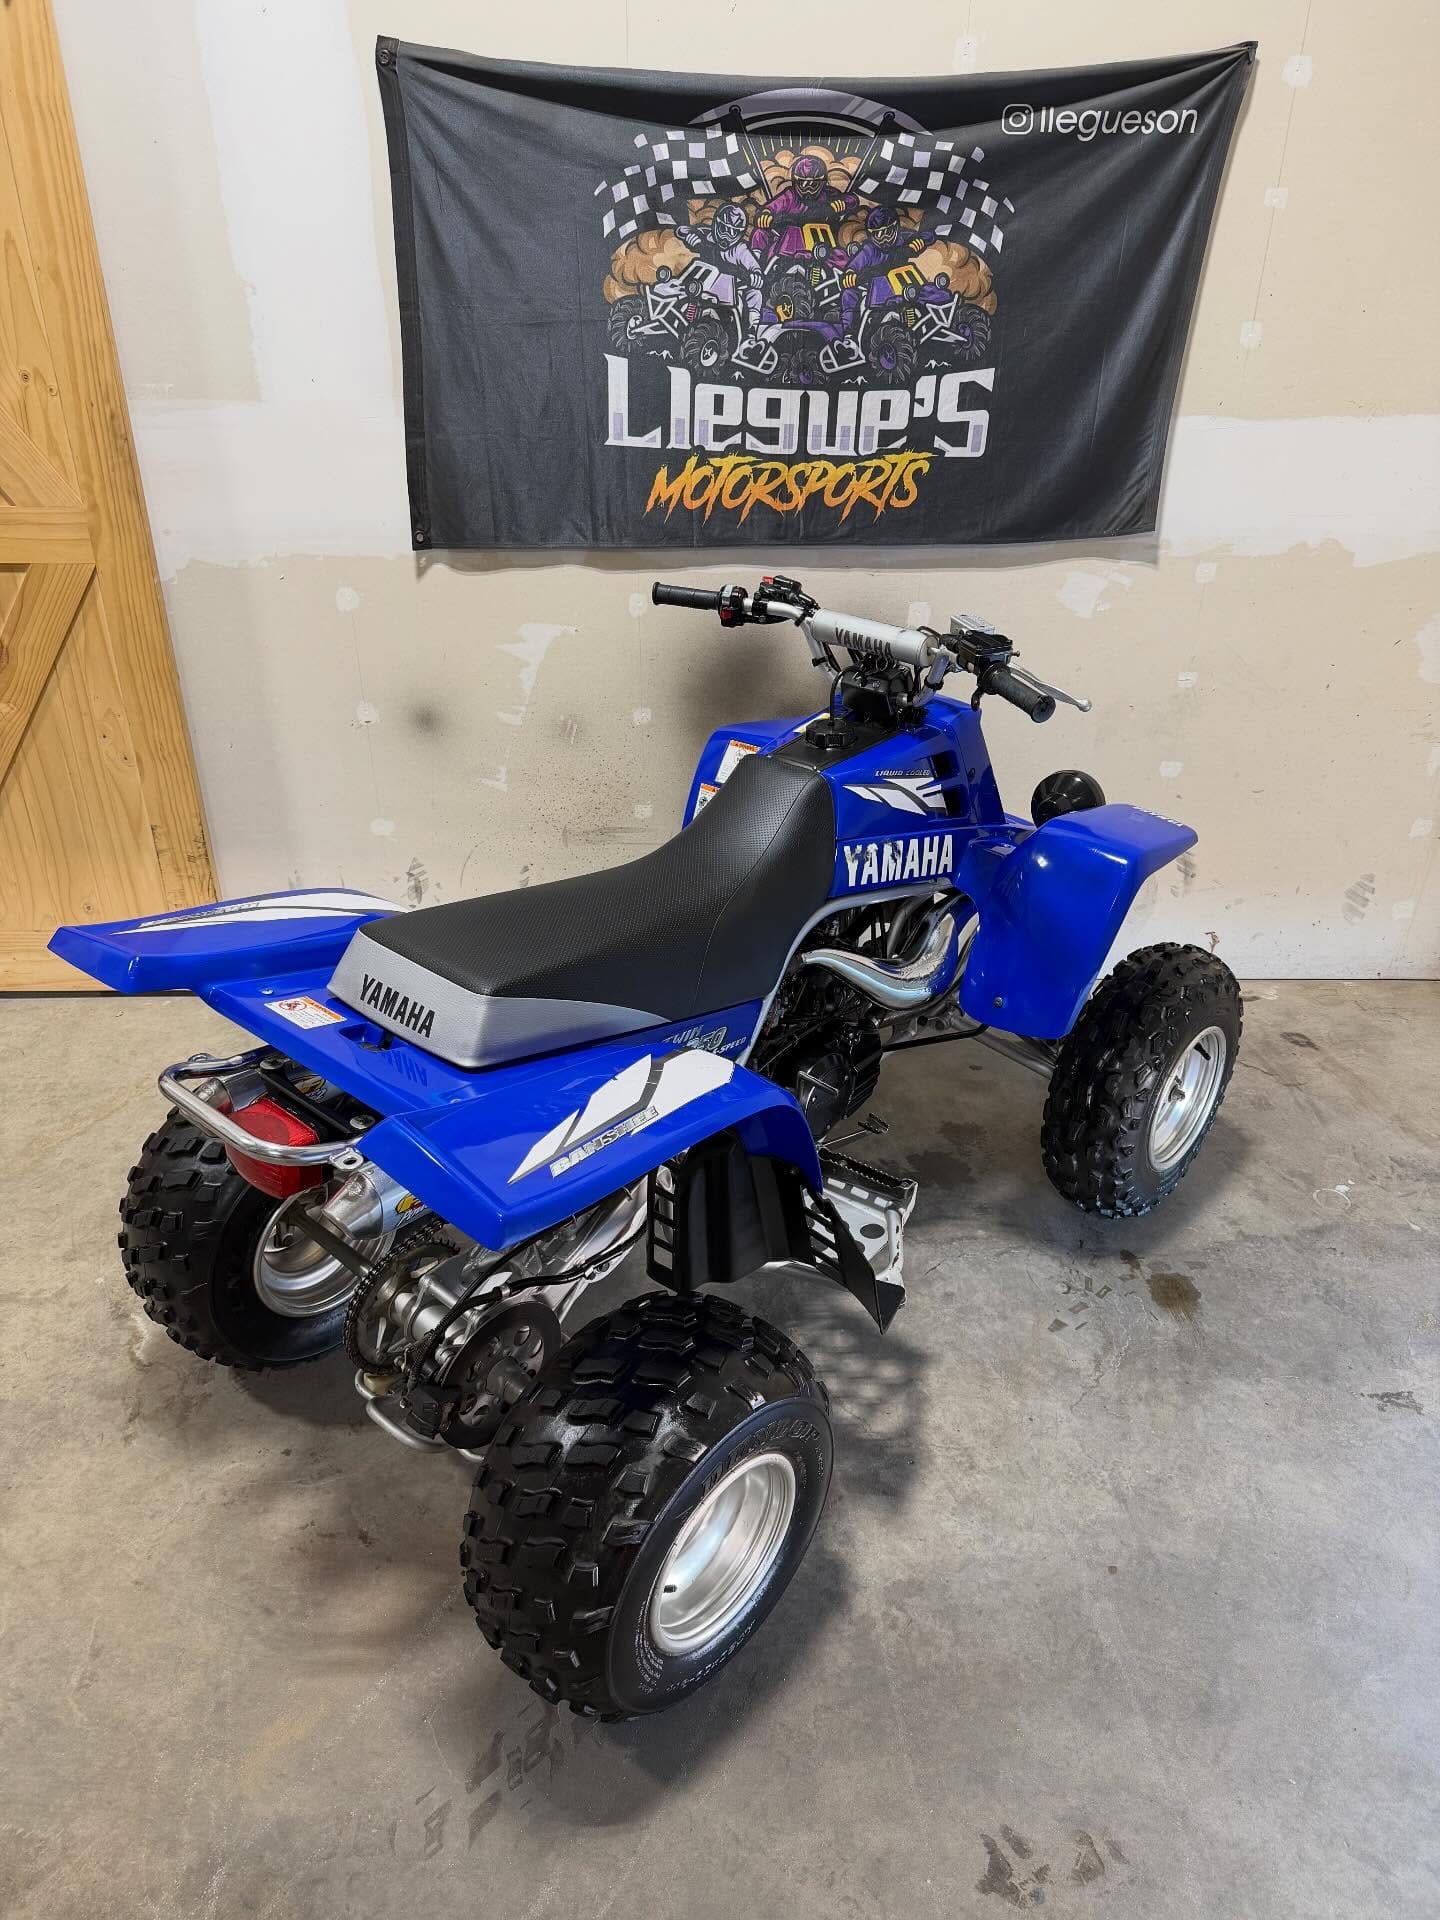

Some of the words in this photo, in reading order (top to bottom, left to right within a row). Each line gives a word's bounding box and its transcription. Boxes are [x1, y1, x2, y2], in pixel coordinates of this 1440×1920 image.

[643, 450, 939, 530] MOTORSPORTS
[835, 626, 894, 659] YAMAHA
[843, 834, 953, 887] YAMAHA
[360, 973, 436, 1039] YAMAHA
[549, 1105, 660, 1179] BANSHEE
